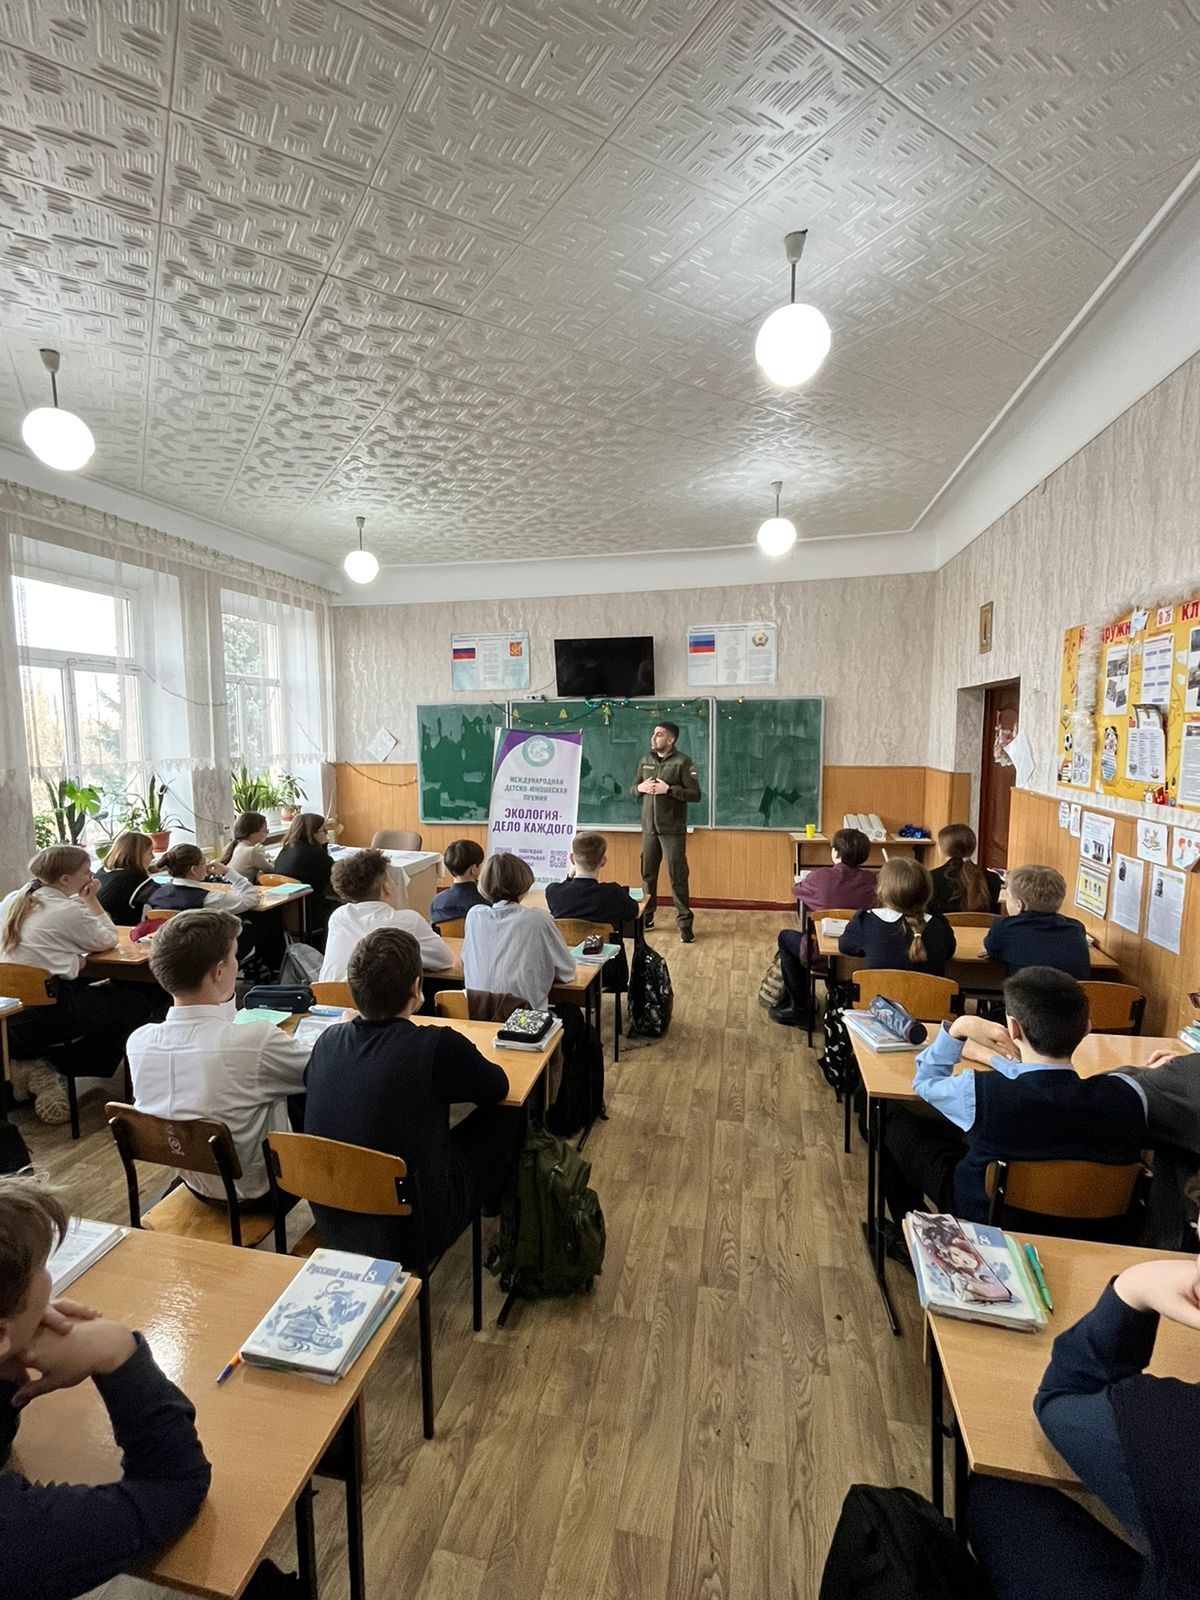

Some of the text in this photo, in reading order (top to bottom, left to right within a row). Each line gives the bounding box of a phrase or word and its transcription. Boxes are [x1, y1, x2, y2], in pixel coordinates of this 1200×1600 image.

[509, 776, 564, 785] МЕЖДУНАРОДНАЯ
[492, 821, 573, 836] ДЕЛО КАЖДОГО
[364, 1270, 378, 1281] 8
